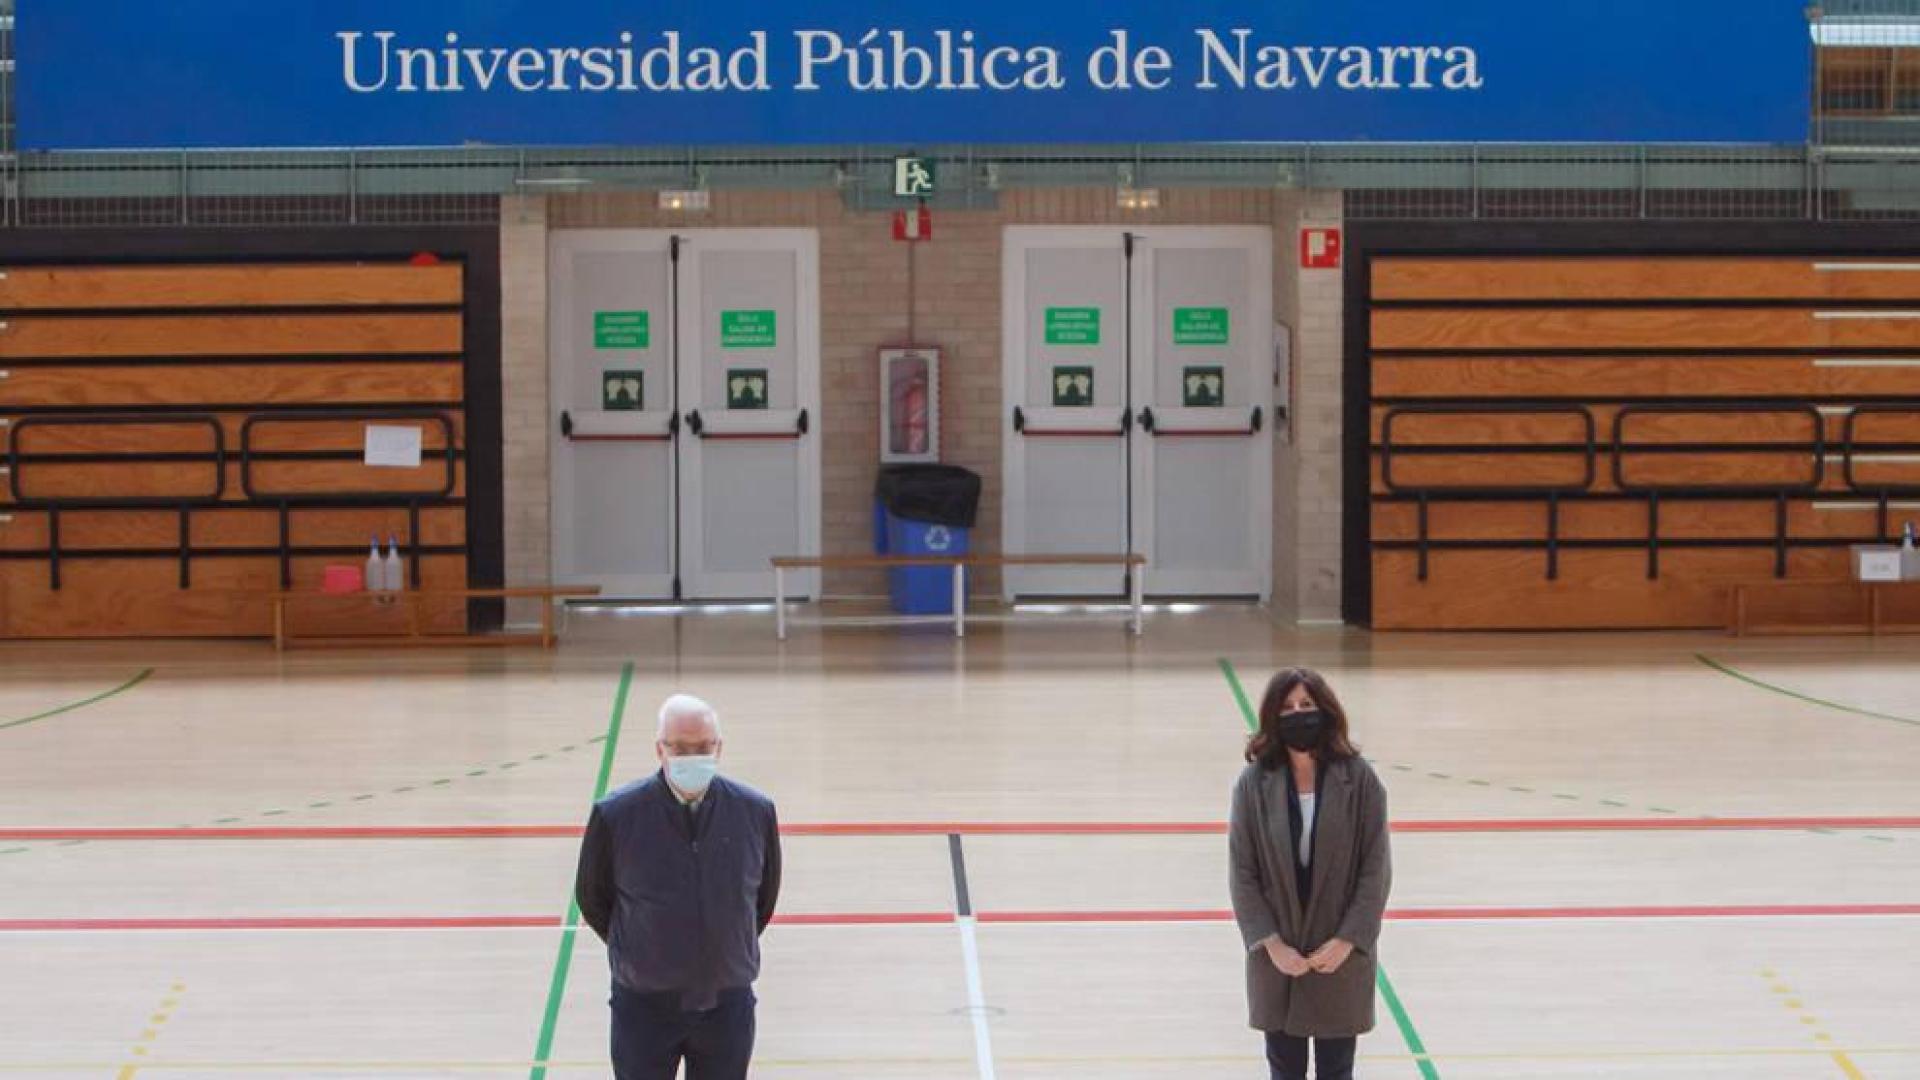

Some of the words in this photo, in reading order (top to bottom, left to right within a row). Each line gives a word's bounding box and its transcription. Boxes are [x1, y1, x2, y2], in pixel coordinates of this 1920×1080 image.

[337, 30, 770, 92] Universidad
[795, 28, 1065, 91] Pública
[1088, 29, 1171, 90] de
[1196, 28, 1482, 90] Navarra
